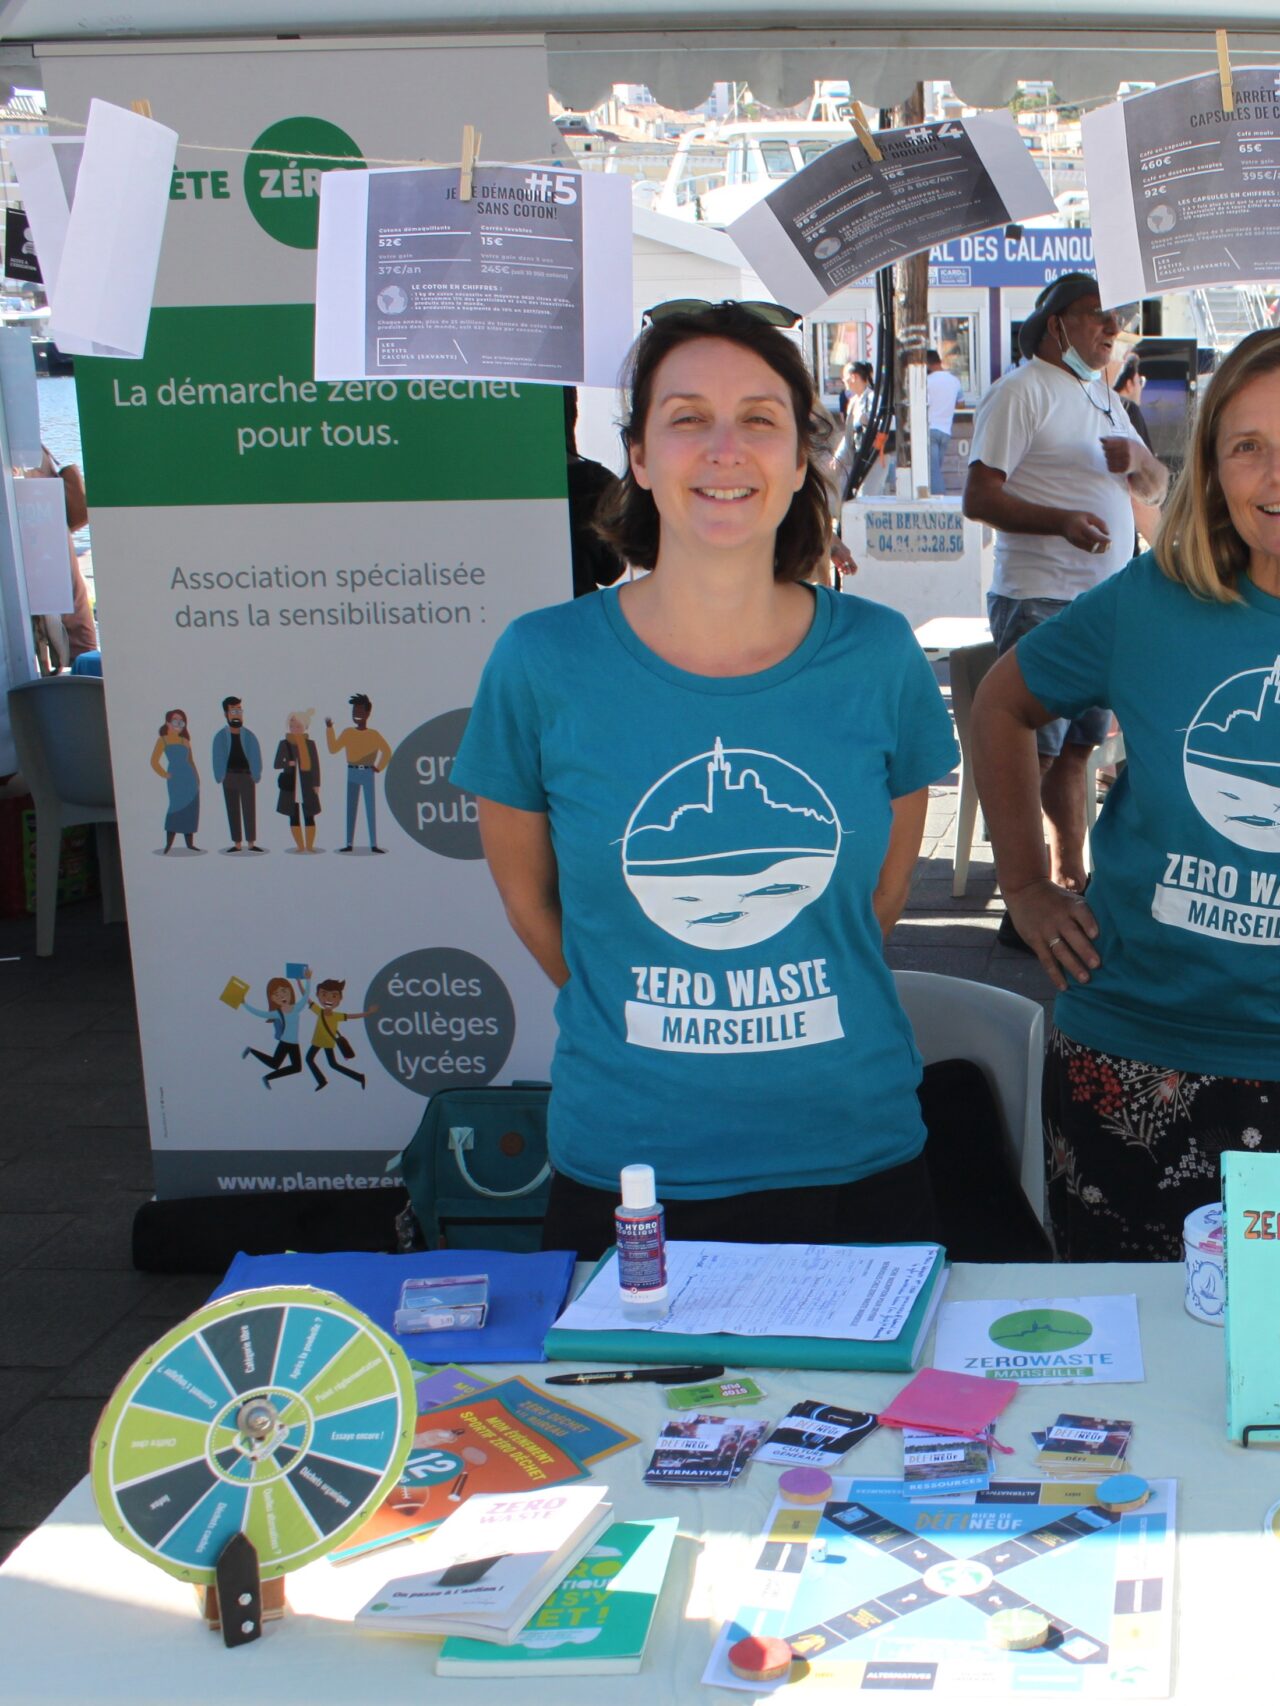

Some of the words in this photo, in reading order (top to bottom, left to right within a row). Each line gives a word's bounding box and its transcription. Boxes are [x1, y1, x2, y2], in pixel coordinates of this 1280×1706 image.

[1190, 107, 1250, 128] CAPSULES
[1255, 107, 1269, 119] DE
[905, 122, 965, 145] #4
[1239, 143, 1263, 153] 65€
[1141, 157, 1172, 171] 460€
[259, 161, 348, 199] ZÉR
[446, 187, 457, 200] JE
[525, 172, 577, 205] #5
[1144, 185, 1167, 198] 92€
[477, 202, 509, 216] SANS
[514, 205, 558, 219] COTON!
[378, 238, 402, 247] 52€
[481, 237, 503, 246] 15€
[961, 236, 998, 261] DES
[378, 265, 422, 275] 37€/an
[481, 265, 510, 275] 245€
[113, 379, 147, 406] La
[156, 376, 317, 405] démarche
[236, 424, 312, 455] pour
[321, 422, 400, 446] tous.
[866, 512, 893, 530] Noël
[897, 512, 963, 530] BERANGER
[170, 565, 327, 590] Association
[336, 562, 486, 598] spécialisée
[175, 604, 239, 628] dans
[247, 603, 270, 626] la
[278, 601, 471, 627] sensibilisation
[416, 754, 455, 785] gr
[1163, 852, 1239, 899] ZERO
[387, 972, 482, 997] écoles
[631, 966, 716, 1007] ZERO
[726, 958, 831, 1008] WASTE
[377, 1011, 498, 1041] collèges
[662, 1011, 807, 1045] MARSEILLE
[397, 1050, 486, 1080] lycées
[217, 1171, 406, 1193] www.planetezer
[625, 1222, 657, 1231] HYDRO
[964, 1353, 1114, 1369] ZEROWASTE
[993, 1368, 1085, 1378] MARSEILLE
[719, 1382, 741, 1390] PUB
[722, 1388, 749, 1397] STOP
[460, 1411, 497, 1439] SPORTIF
[485, 1416, 509, 1432] MON
[330, 1431, 355, 1441] Essaye
[356, 1431, 378, 1441] encore
[1078, 1432, 1103, 1441] NEUF
[782, 1445, 825, 1457] CULTURE
[934, 1453, 958, 1462] NEUF
[648, 1467, 729, 1477] ALTERNATIVES
[909, 1477, 983, 1491] RESSOURCES
[487, 1497, 568, 1515] ZERO
[479, 1510, 551, 1524] WASTE
[916, 1510, 969, 1529] DÉFI
[969, 1519, 1022, 1530] NEUF
[392, 1590, 406, 1598] On
[408, 1590, 444, 1599] passe
[599, 1607, 609, 1625] !
[867, 1671, 931, 1681] ALTERNATIVES
